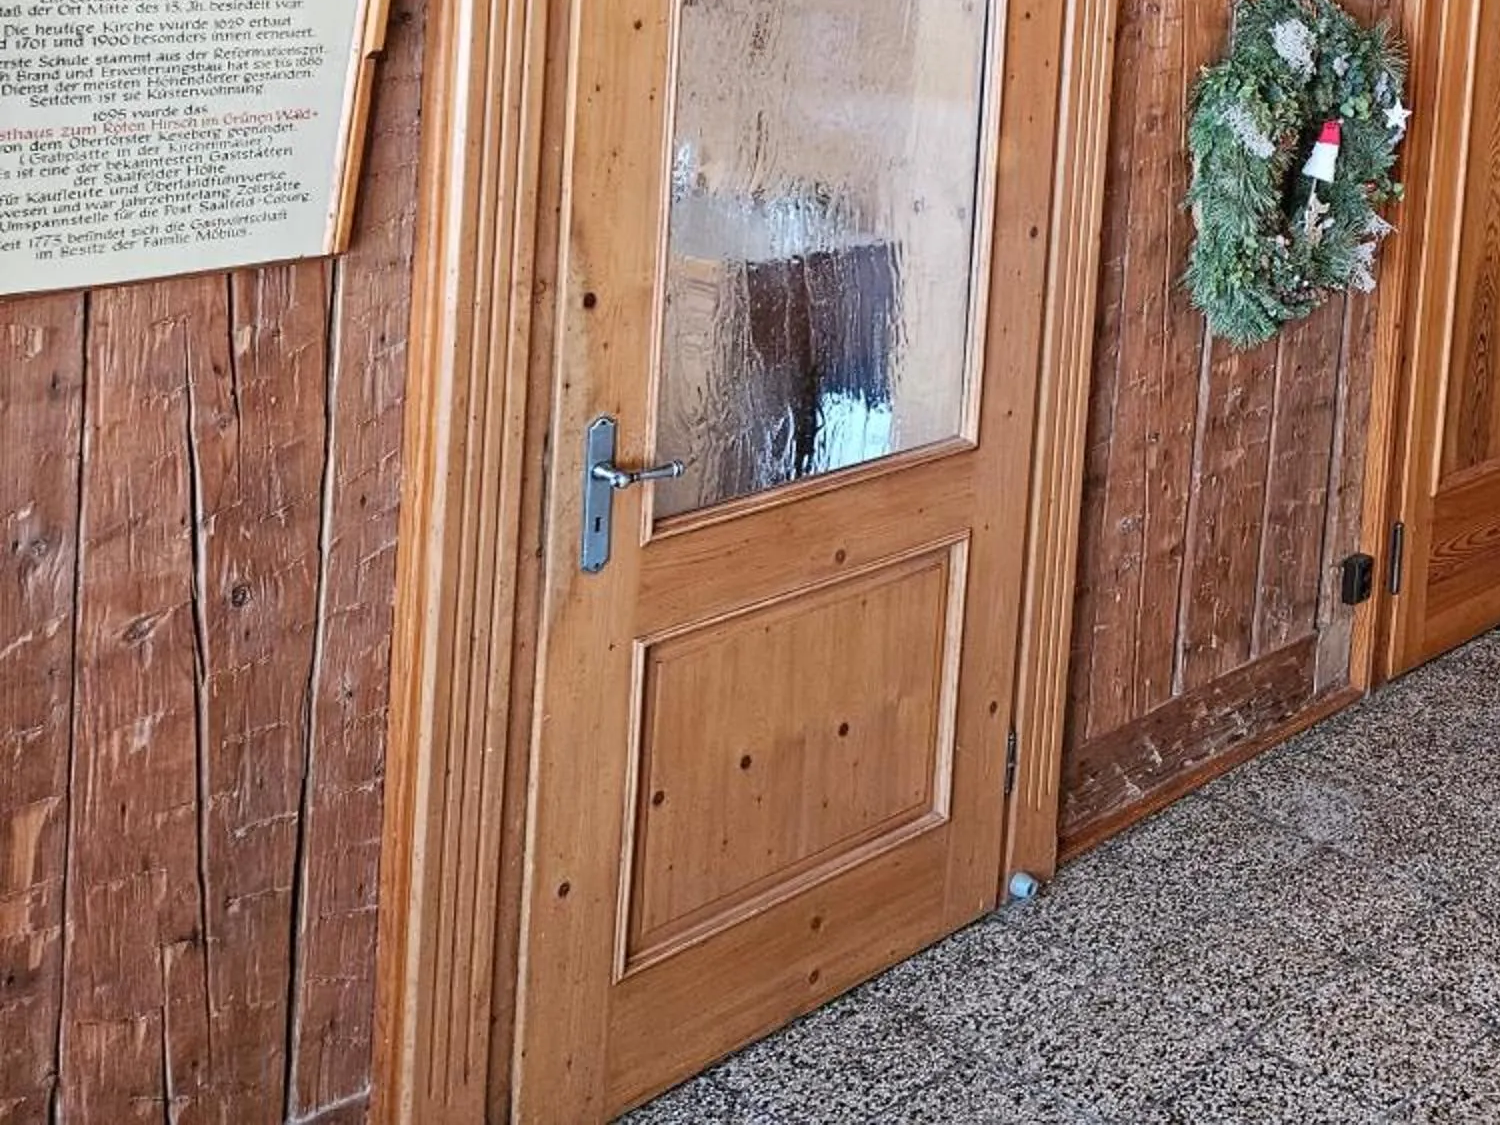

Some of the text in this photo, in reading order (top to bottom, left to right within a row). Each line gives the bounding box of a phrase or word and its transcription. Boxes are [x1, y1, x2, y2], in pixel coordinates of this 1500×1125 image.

[27, 4, 53, 16] der
[57, 4, 82, 16] Ort
[86, 3, 129, 15] Mitte
[135, 2, 160, 14] des
[209, 0, 271, 12] besiedelt
[4, 24, 29, 37] Die
[35, 23, 95, 38] heutige
[103, 21, 156, 34] Kirche
[159, 19, 209, 31] wurde
[53, 34, 84, 48] und
[133, 31, 207, 45] besonders
[211, 30, 251, 42] innen
[38, 54, 89, 68] Schule
[95, 51, 151, 65] stammt
[156, 51, 181, 62] aus
[185, 49, 209, 62] der
[65, 67, 93, 80] und
[227, 60, 249, 72] hat
[253, 59, 273, 70] sie
[1, 82, 49, 96] Dienst
[55, 81, 79, 93] der
[83, 77, 141, 92] meisten
[29, 93, 92, 107] Seitdem
[99, 92, 118, 103] ist
[123, 90, 141, 101] sie
[132, 106, 180, 119] wurde
[184, 104, 209, 116] das
[61, 124, 97, 138] zum
[103, 120, 147, 135] Roten
[151, 117, 197, 131] Hirsch
[29, 139, 63, 152] dem
[116, 146, 131, 157] in
[138, 145, 161, 156] der
[17, 167, 34, 178] ist
[39, 164, 71, 176] eine
[76, 161, 100, 174] der
[74, 175, 97, 187] der
[103, 167, 182, 186] Saalfelder
[26, 187, 104, 204] Kaufleute
[109, 183, 139, 196] und
[53, 201, 81, 214] und
[86, 198, 116, 210] war
[139, 206, 159, 218] die
[164, 203, 192, 216] Post
[67, 226, 125, 244] befindet
[131, 223, 159, 238] sich
[165, 220, 186, 232] die
[36, 249, 53, 259] im
[60, 242, 105, 258] Besitz
[112, 238, 137, 252] der
